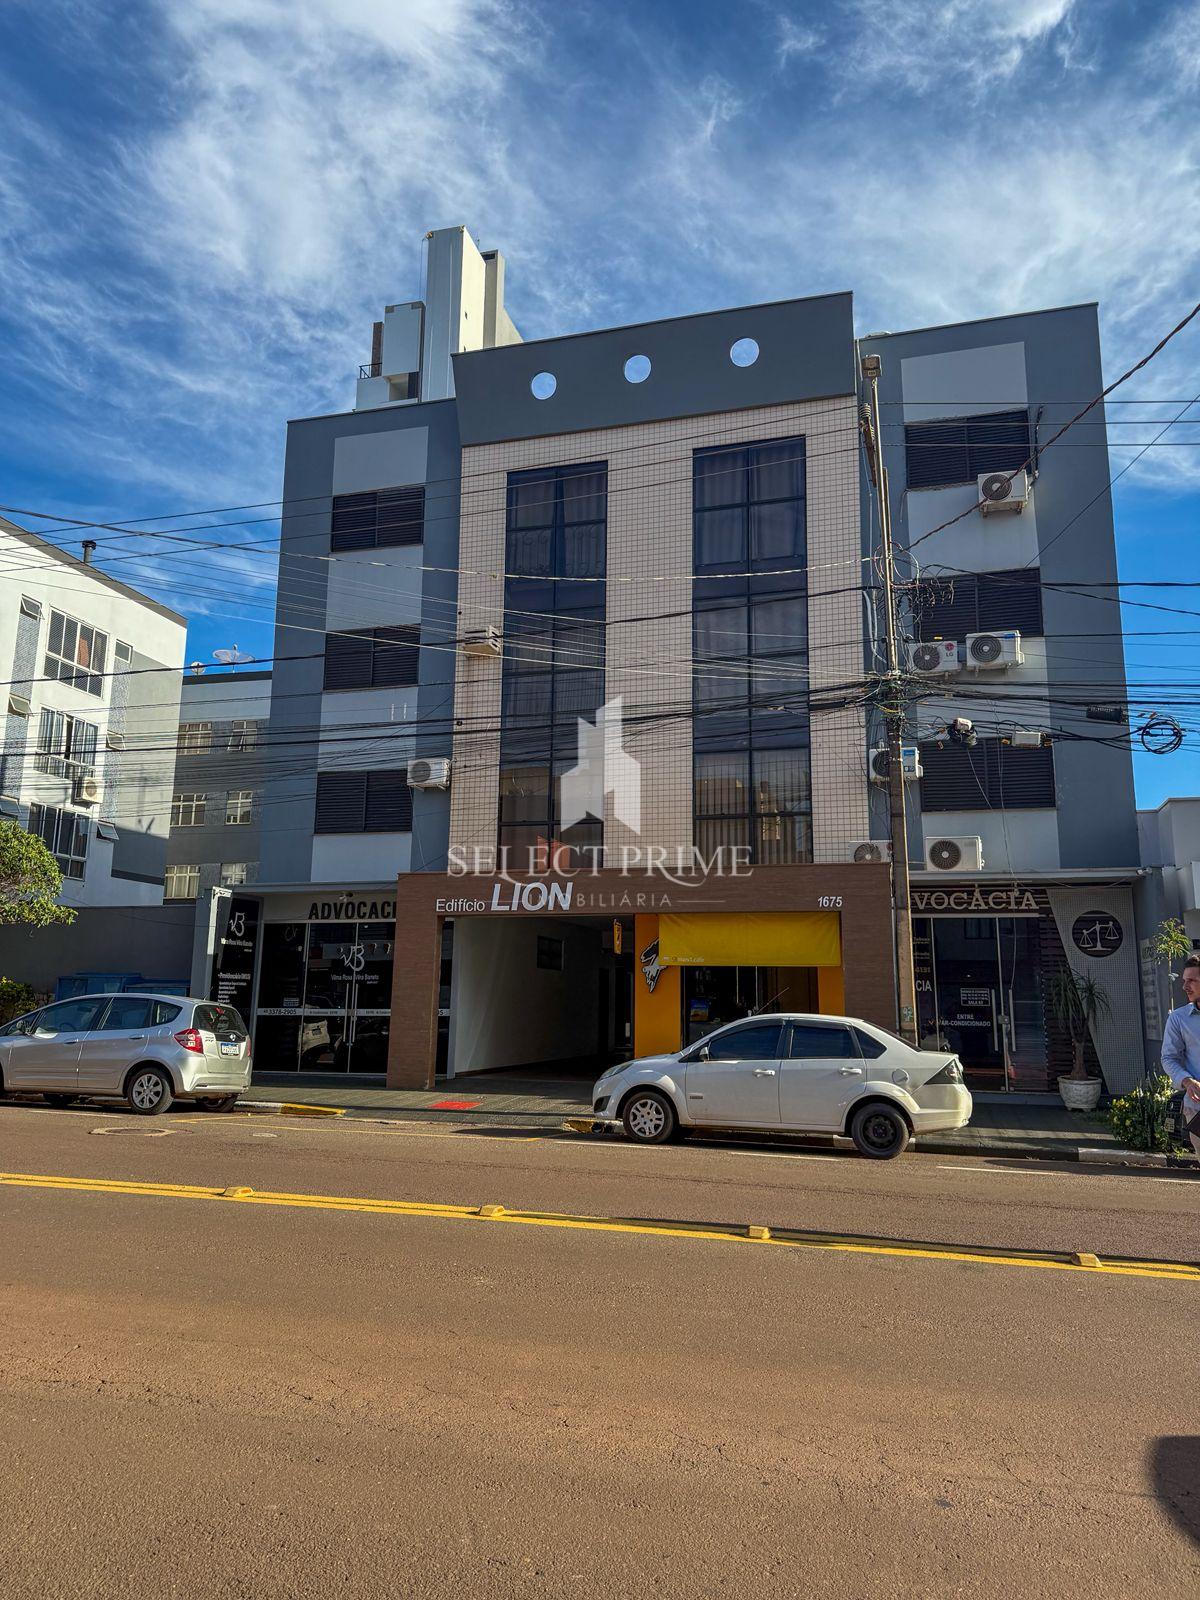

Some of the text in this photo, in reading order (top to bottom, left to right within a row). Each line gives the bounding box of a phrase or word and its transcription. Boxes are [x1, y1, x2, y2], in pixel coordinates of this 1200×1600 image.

[435, 882, 574, 913] Edifício LION
[817, 896, 843, 908] 1675
[911, 891, 1040, 910] VOCACIA
[915, 980, 932, 992] CIA
